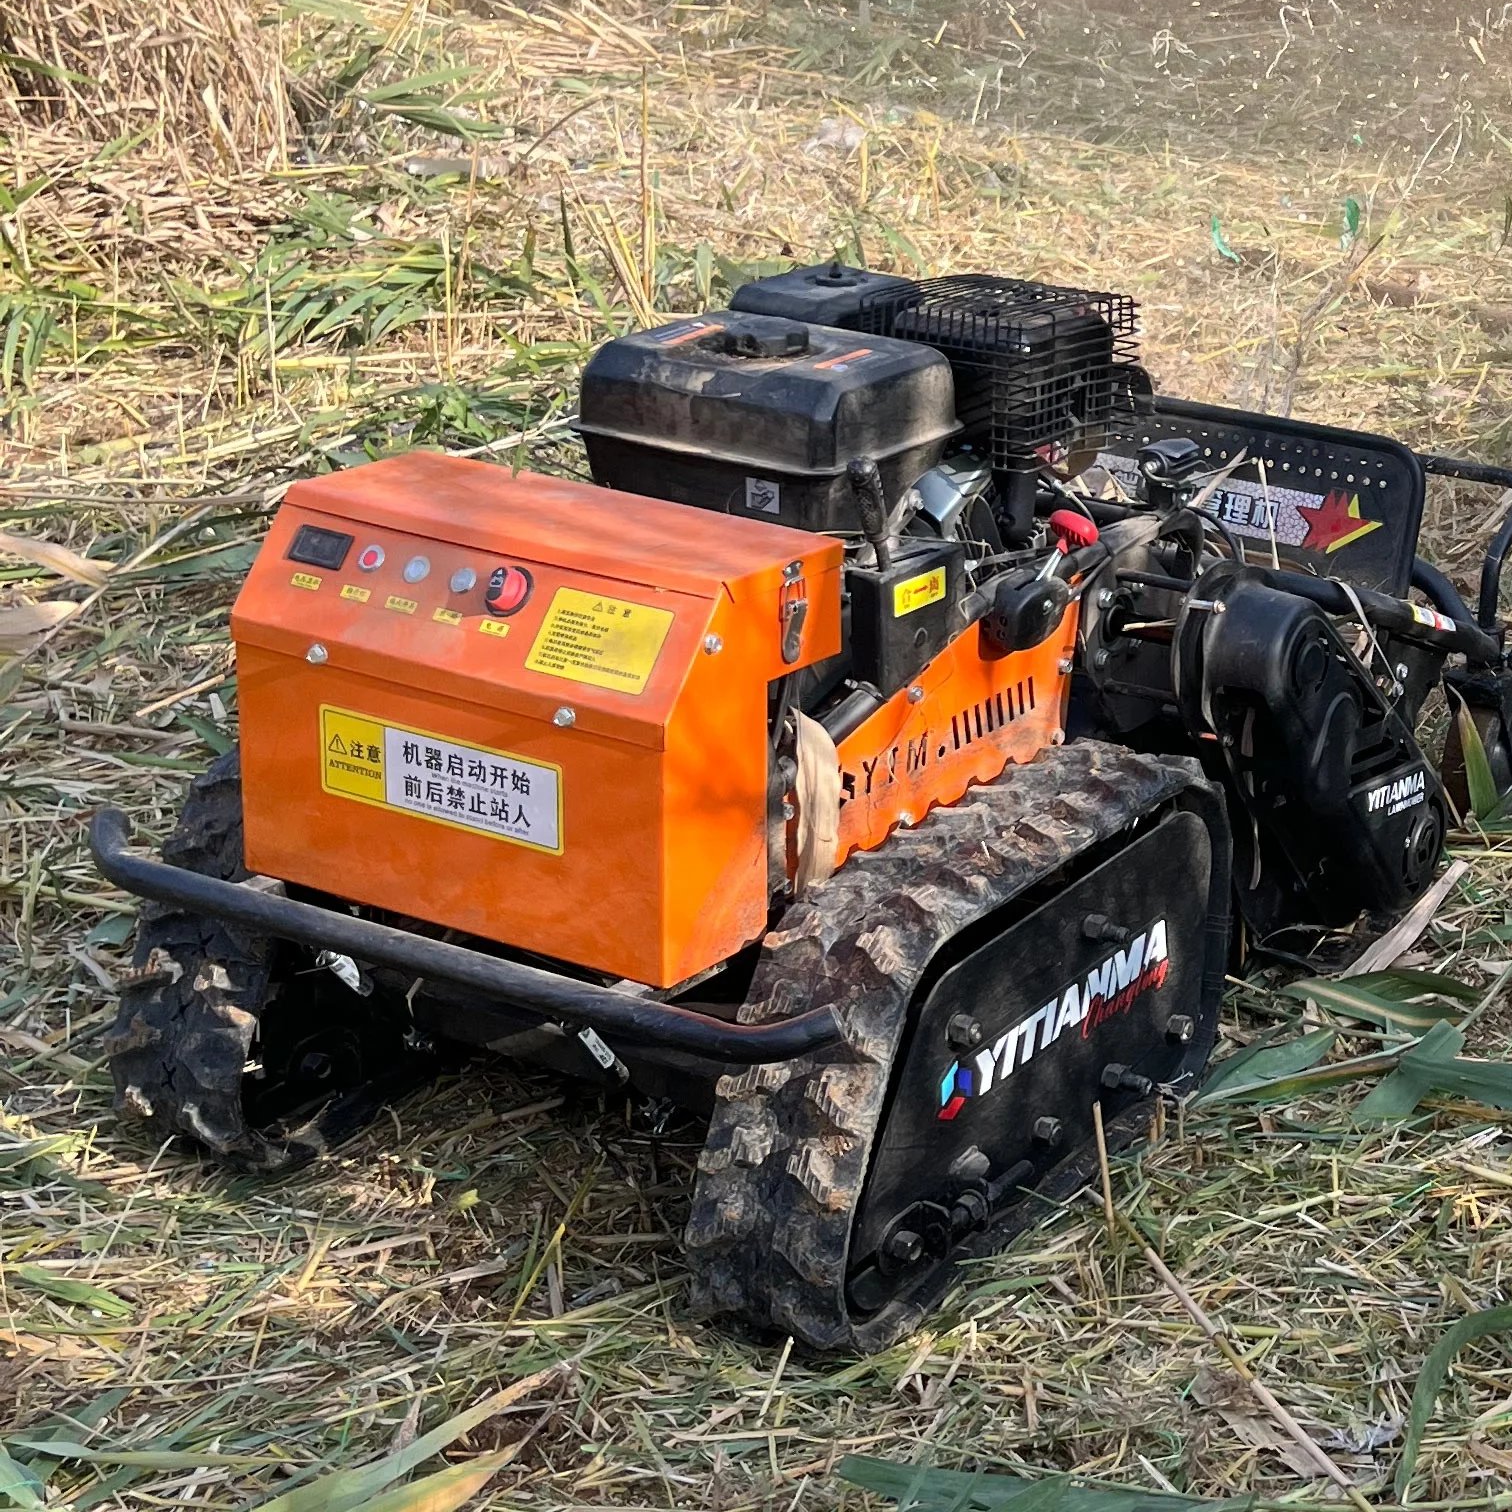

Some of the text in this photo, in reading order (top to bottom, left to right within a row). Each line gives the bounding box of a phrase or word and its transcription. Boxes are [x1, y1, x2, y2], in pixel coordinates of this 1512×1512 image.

[329, 759, 382, 780] ATTENTION
[350, 740, 381, 763] 注意
[403, 741, 530, 796] 机器启动开始
[403, 774, 531, 828] 前后禁止站人
[1368, 770, 1425, 812] YITIANMA
[975, 919, 1168, 1096] YITIANMA
